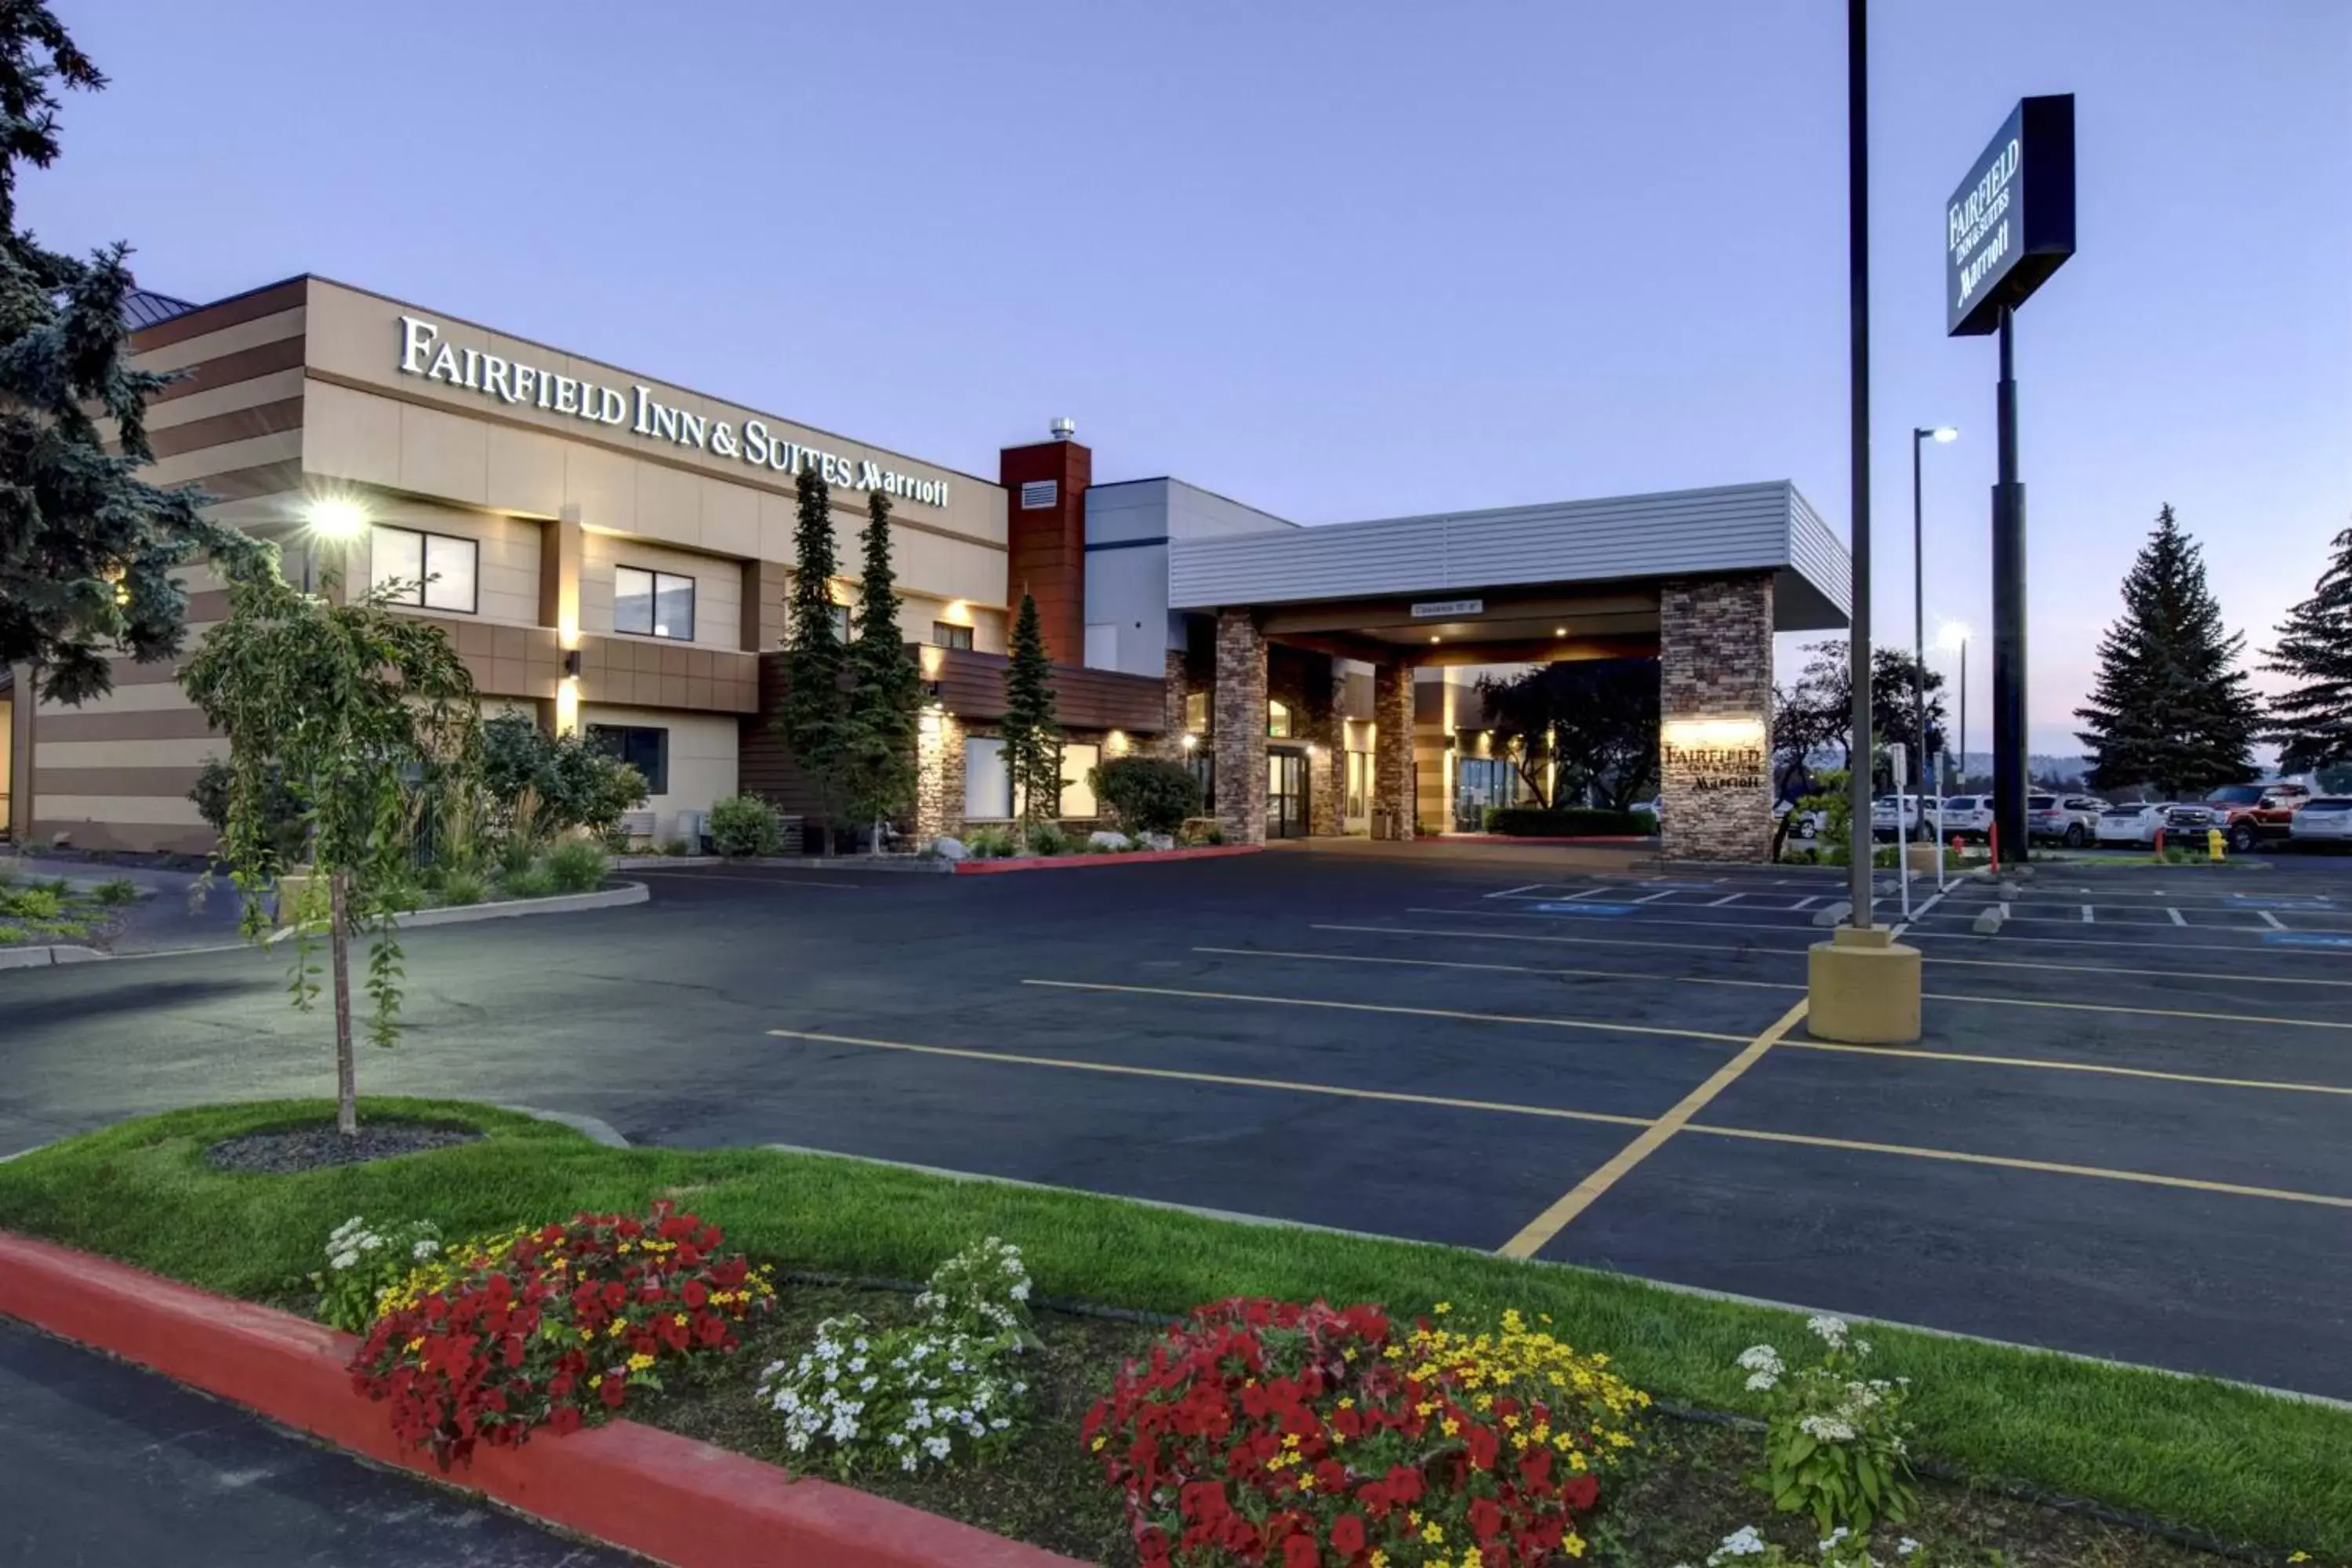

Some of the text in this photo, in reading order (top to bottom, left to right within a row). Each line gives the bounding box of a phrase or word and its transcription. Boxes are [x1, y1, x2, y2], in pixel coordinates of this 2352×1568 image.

[1949, 138, 2020, 251] FAIRFIELD
[1958, 219, 2009, 308] Marriott
[400, 315, 948, 507] FAIRFIELD INN & SUITES Marriott
